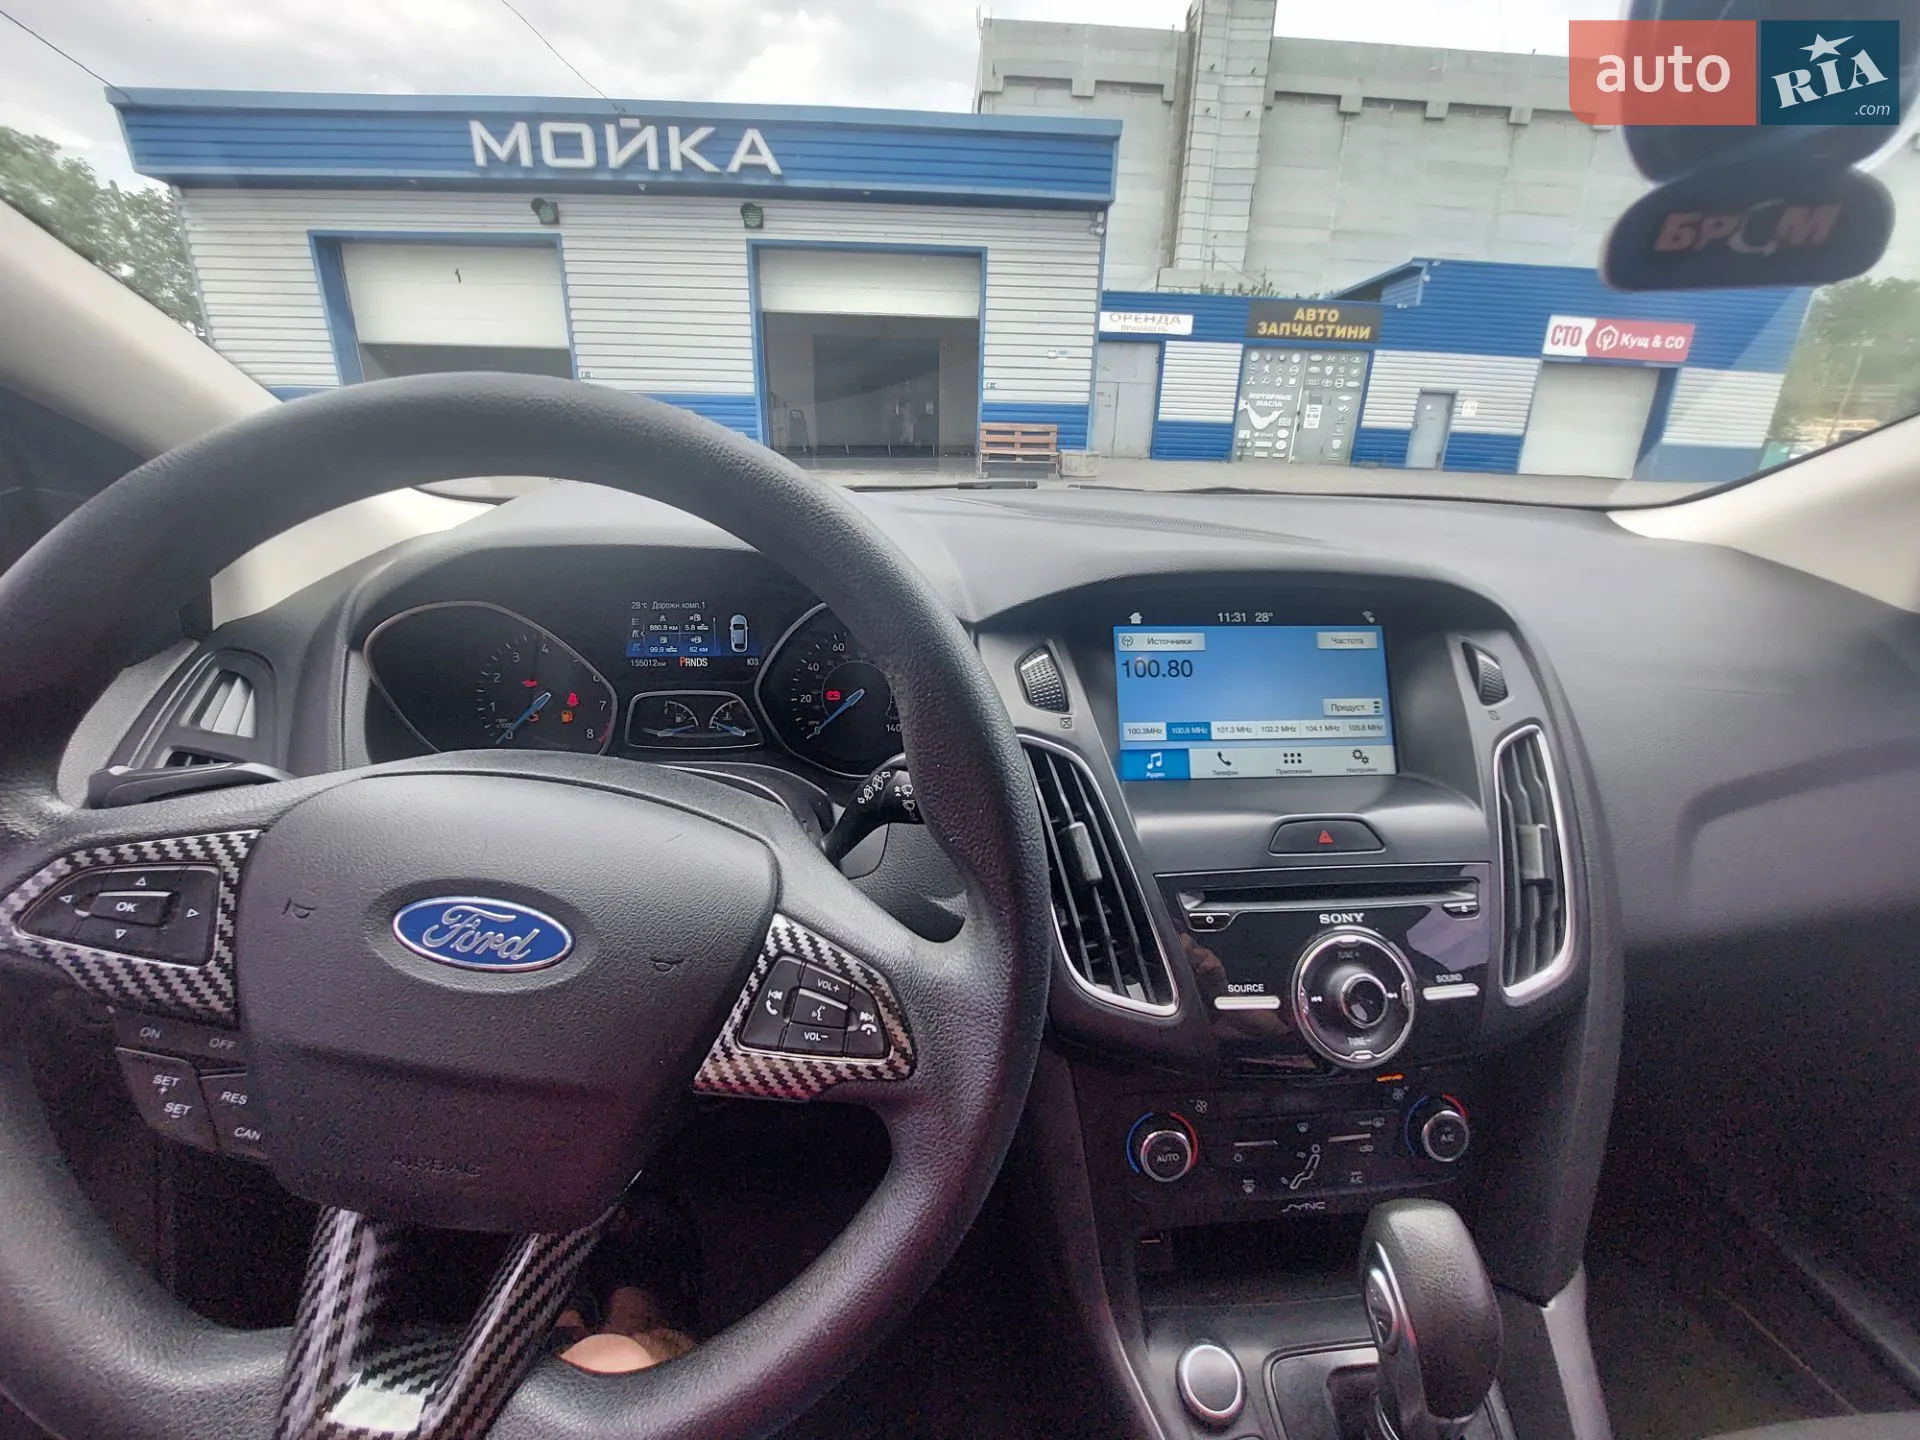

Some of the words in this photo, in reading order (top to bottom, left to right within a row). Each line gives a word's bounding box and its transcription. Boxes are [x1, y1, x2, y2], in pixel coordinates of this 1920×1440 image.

[468, 117, 783, 176] МОЙКА
[1108, 312, 1182, 326] ОРЕНДА
[1294, 307, 1340, 323] АВТО
[1257, 321, 1372, 340] ЗАПЧАСТИНИ
[1550, 324, 1583, 348] СТО
[1652, 334, 1663, 348] &
[1248, 392, 1293, 401] МОТОРНЫЕ
[1255, 400, 1283, 408] МАСЛА
[1217, 612, 1247, 623] 11:31
[1254, 611, 1274, 623] 28°
[832, 642, 845, 652] 60
[1147, 637, 1193, 646] Источники
[1330, 636, 1365, 646] Частота
[541, 643, 549, 654] 4
[512, 651, 520, 662] 3
[807, 662, 820, 672] 40
[1121, 659, 1194, 678] 100.80
[493, 672, 501, 683] 2
[800, 694, 812, 703] 20
[489, 702, 496, 712] 1
[599, 700, 607, 711] 7
[1330, 702, 1367, 713] Предуст.
[586, 728, 594, 739] 8
[115, 901, 137, 913] OK
[1318, 912, 1365, 924] SONY
[422, 905, 541, 961] Ford
[1227, 983, 1265, 993] SOURCE
[140, 1026, 162, 1039] ON
[209, 1037, 237, 1050] OFF
[153, 1074, 181, 1087] SET
[220, 1091, 248, 1105] RES
[164, 1101, 192, 1115] SET
[234, 1126, 262, 1141] CAN
[1156, 1153, 1180, 1162] AUTO
